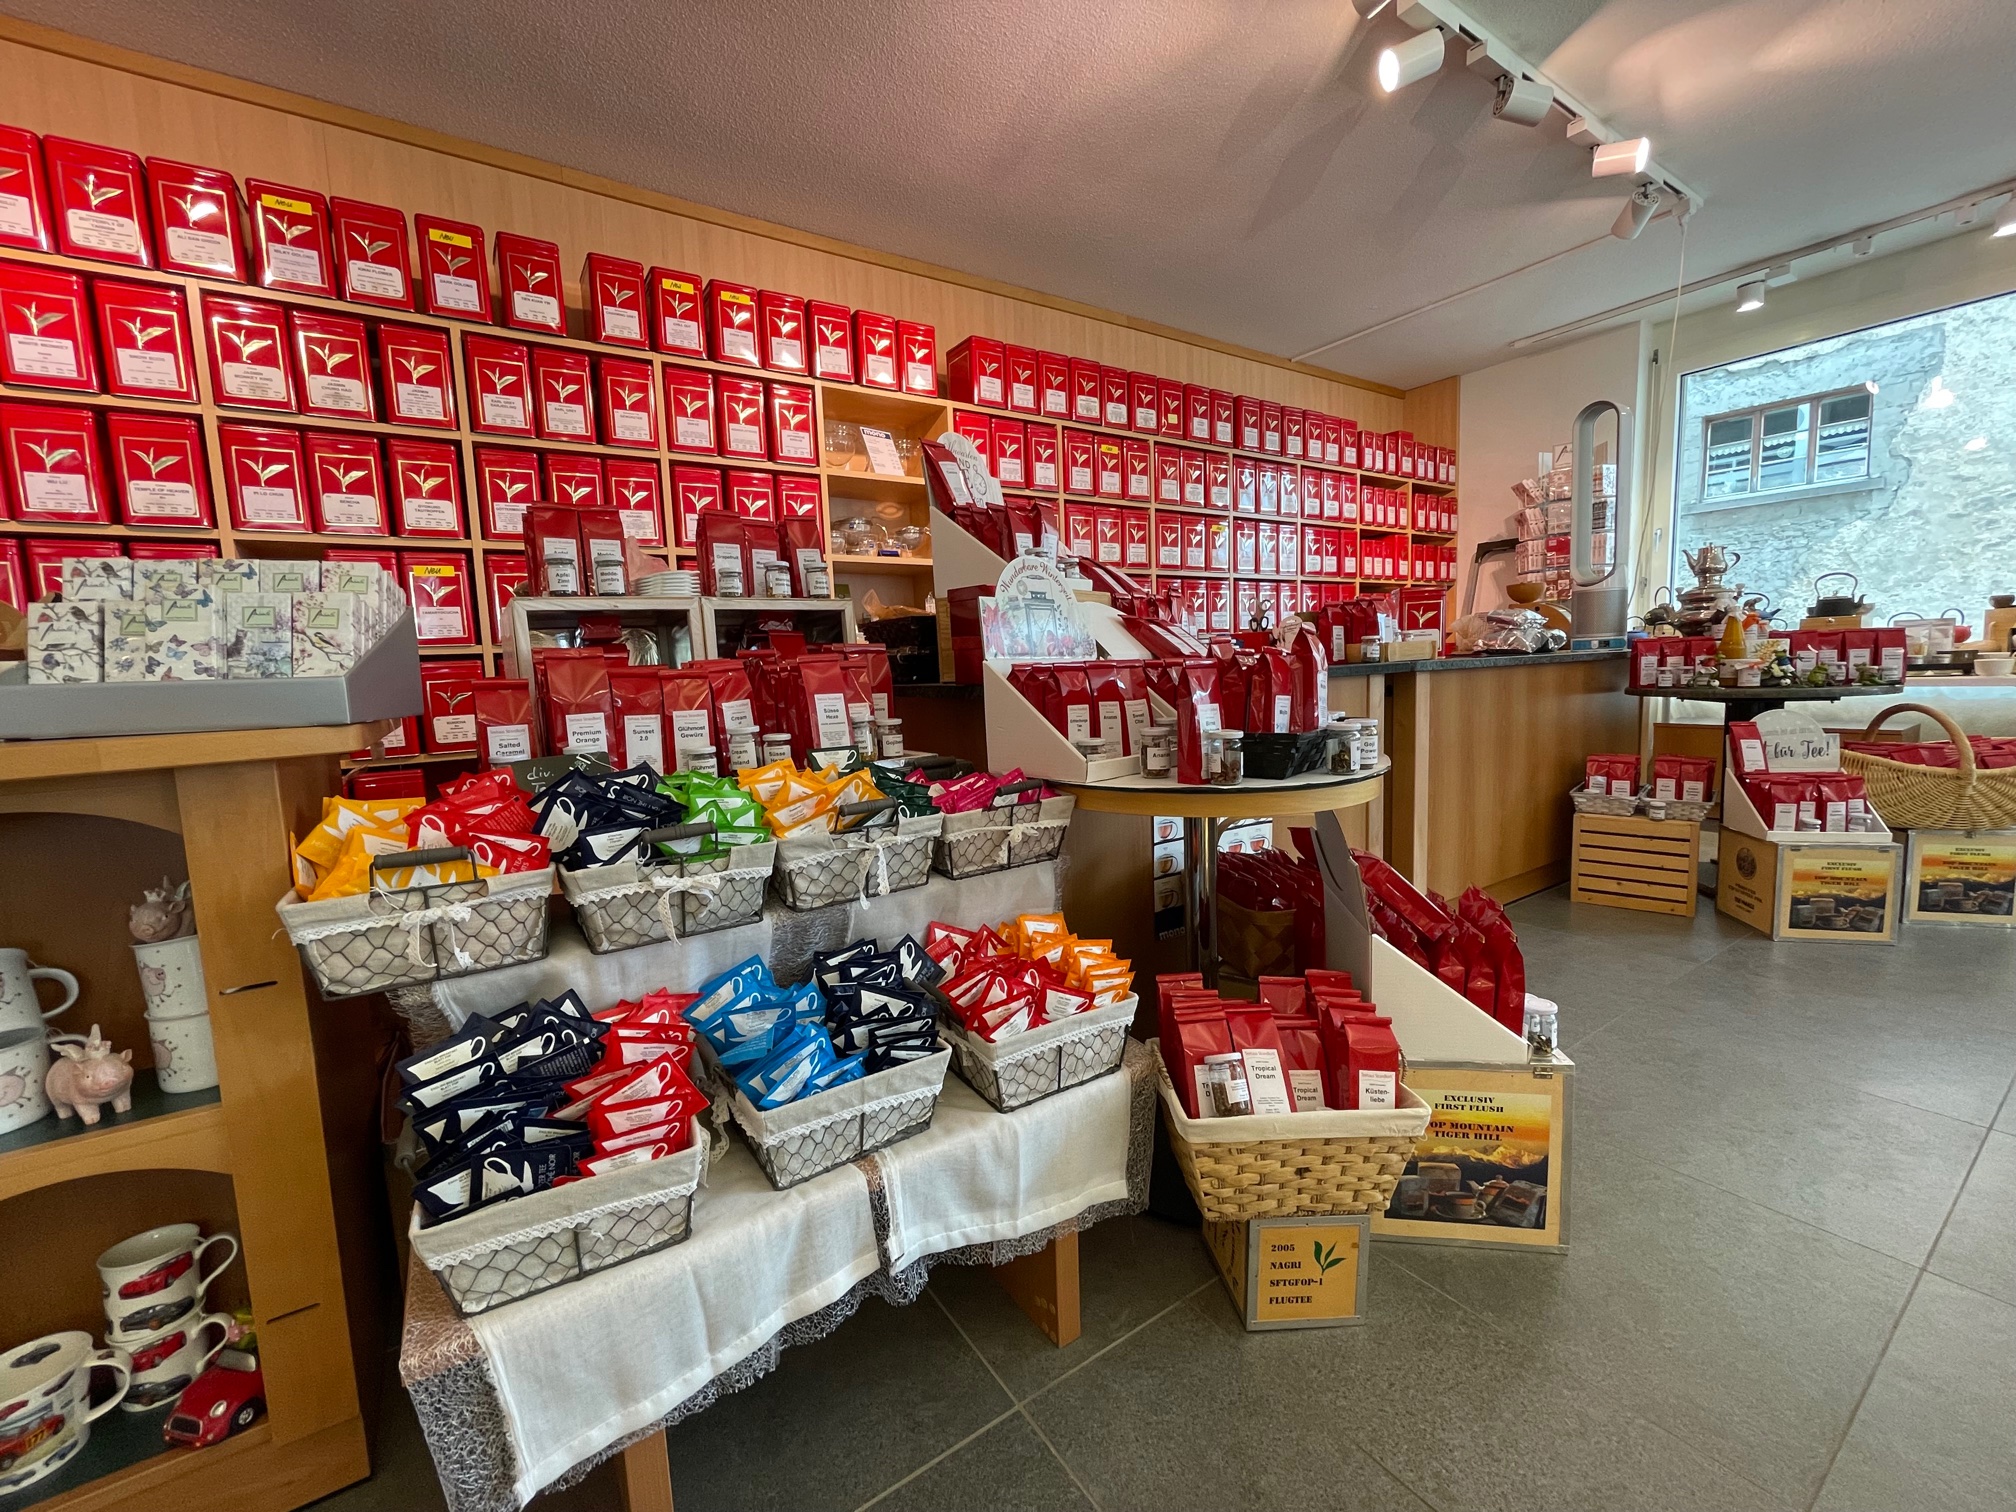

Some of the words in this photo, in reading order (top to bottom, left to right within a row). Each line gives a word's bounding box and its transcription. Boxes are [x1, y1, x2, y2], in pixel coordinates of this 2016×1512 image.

[959, 457, 971, 469] ND
[424, 567, 442, 575] Neu
[572, 729, 602, 737] Premium
[575, 736, 600, 744] Orange
[498, 741, 521, 749] Salted
[1774, 742, 1796, 760] für
[1801, 739, 1830, 760] Tee!
[495, 748, 526, 756] Caramel
[1251, 1065, 1277, 1073] Tropical
[1293, 1086, 1319, 1095] Tropical
[1365, 1087, 1390, 1095] Küsten-
[1296, 1094, 1317, 1102] Dream
[1369, 1095, 1386, 1103] liebe
[1444, 1094, 1495, 1104] EXCLUSIV
[1434, 1103, 1467, 1112] FIRST
[1469, 1104, 1504, 1113] FLUSH
[1449, 1122, 1514, 1133] MOUNTAIN
[1433, 1130, 1470, 1140] TIGER
[1474, 1132, 1503, 1142] HILL
[1270, 1243, 1295, 1252] 2005
[1270, 1260, 1302, 1270] NAGRI
[1269, 1295, 1313, 1305] FLUGTEE
